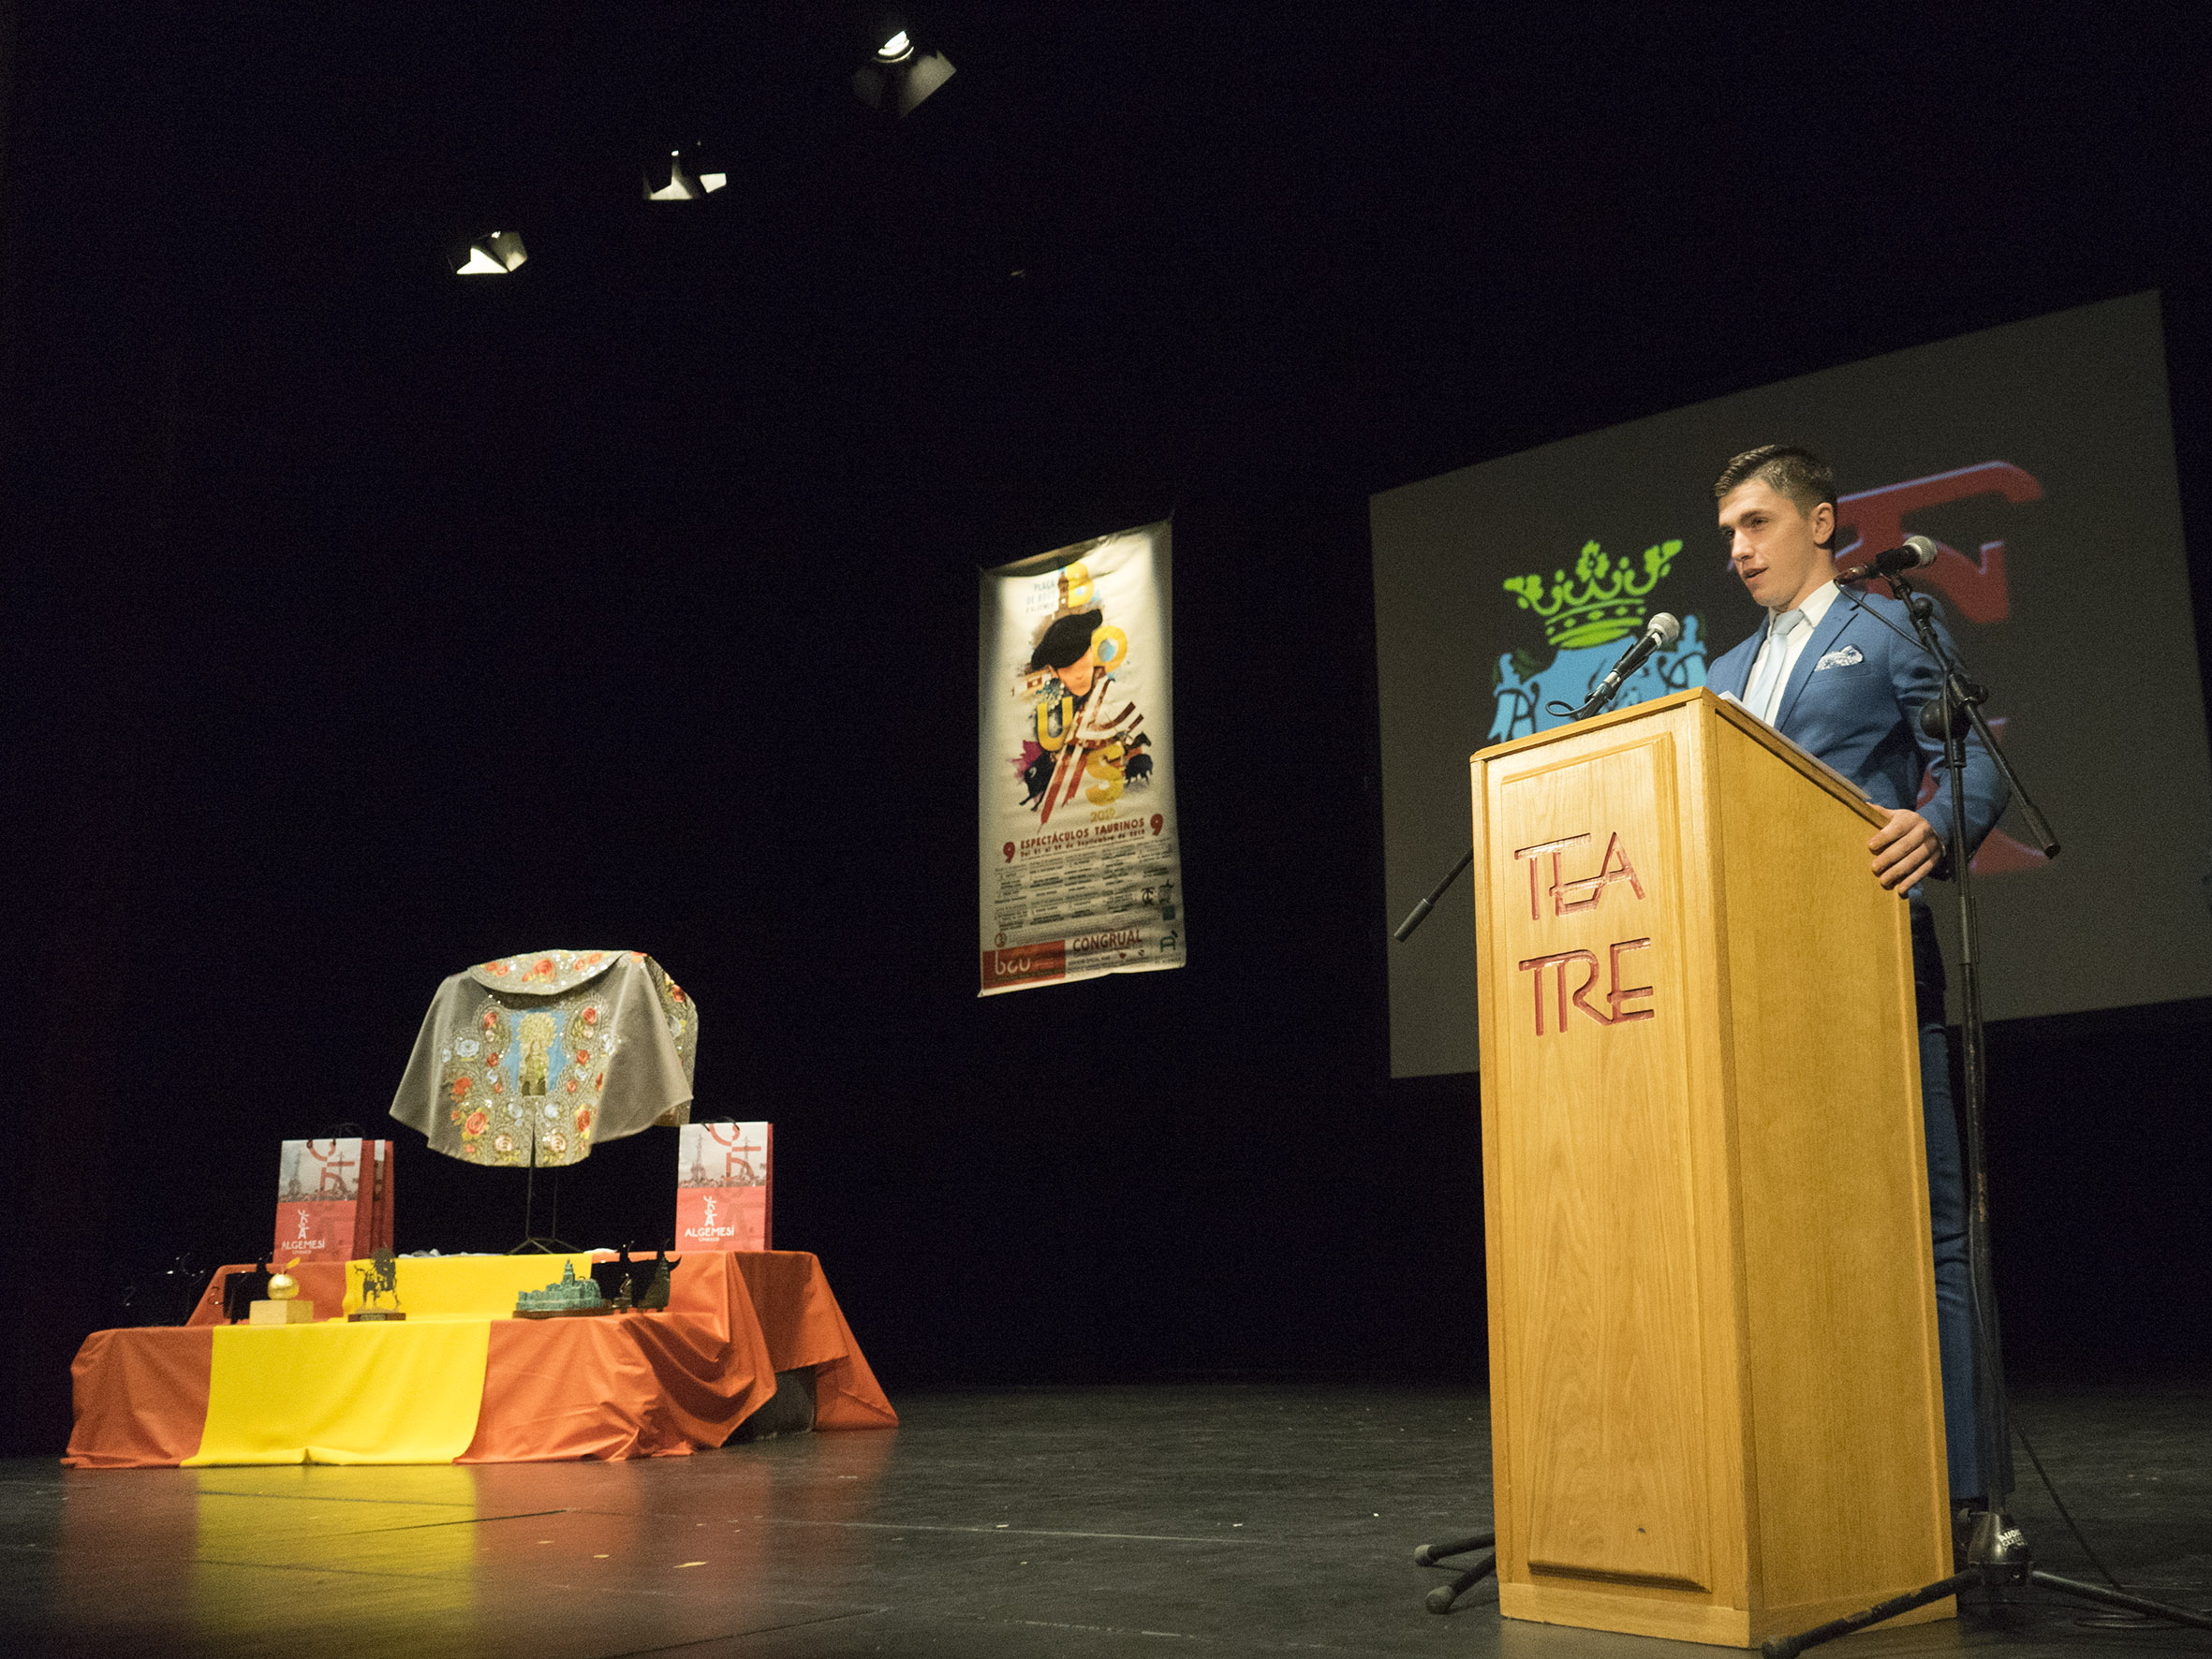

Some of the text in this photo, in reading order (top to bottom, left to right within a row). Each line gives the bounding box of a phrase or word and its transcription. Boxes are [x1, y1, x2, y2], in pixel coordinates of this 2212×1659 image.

[1003, 813, 1163, 863] 9 ESPECTÁCULOS TAURINOS 9
[1513, 831, 1646, 921] TEA
[1072, 927, 1143, 952] CONGRUAL
[1519, 937, 1655, 1036] TRE
[281, 1238, 325, 1250] ALGEMESÍ
[685, 1226, 734, 1237] ALGEMESÍ
